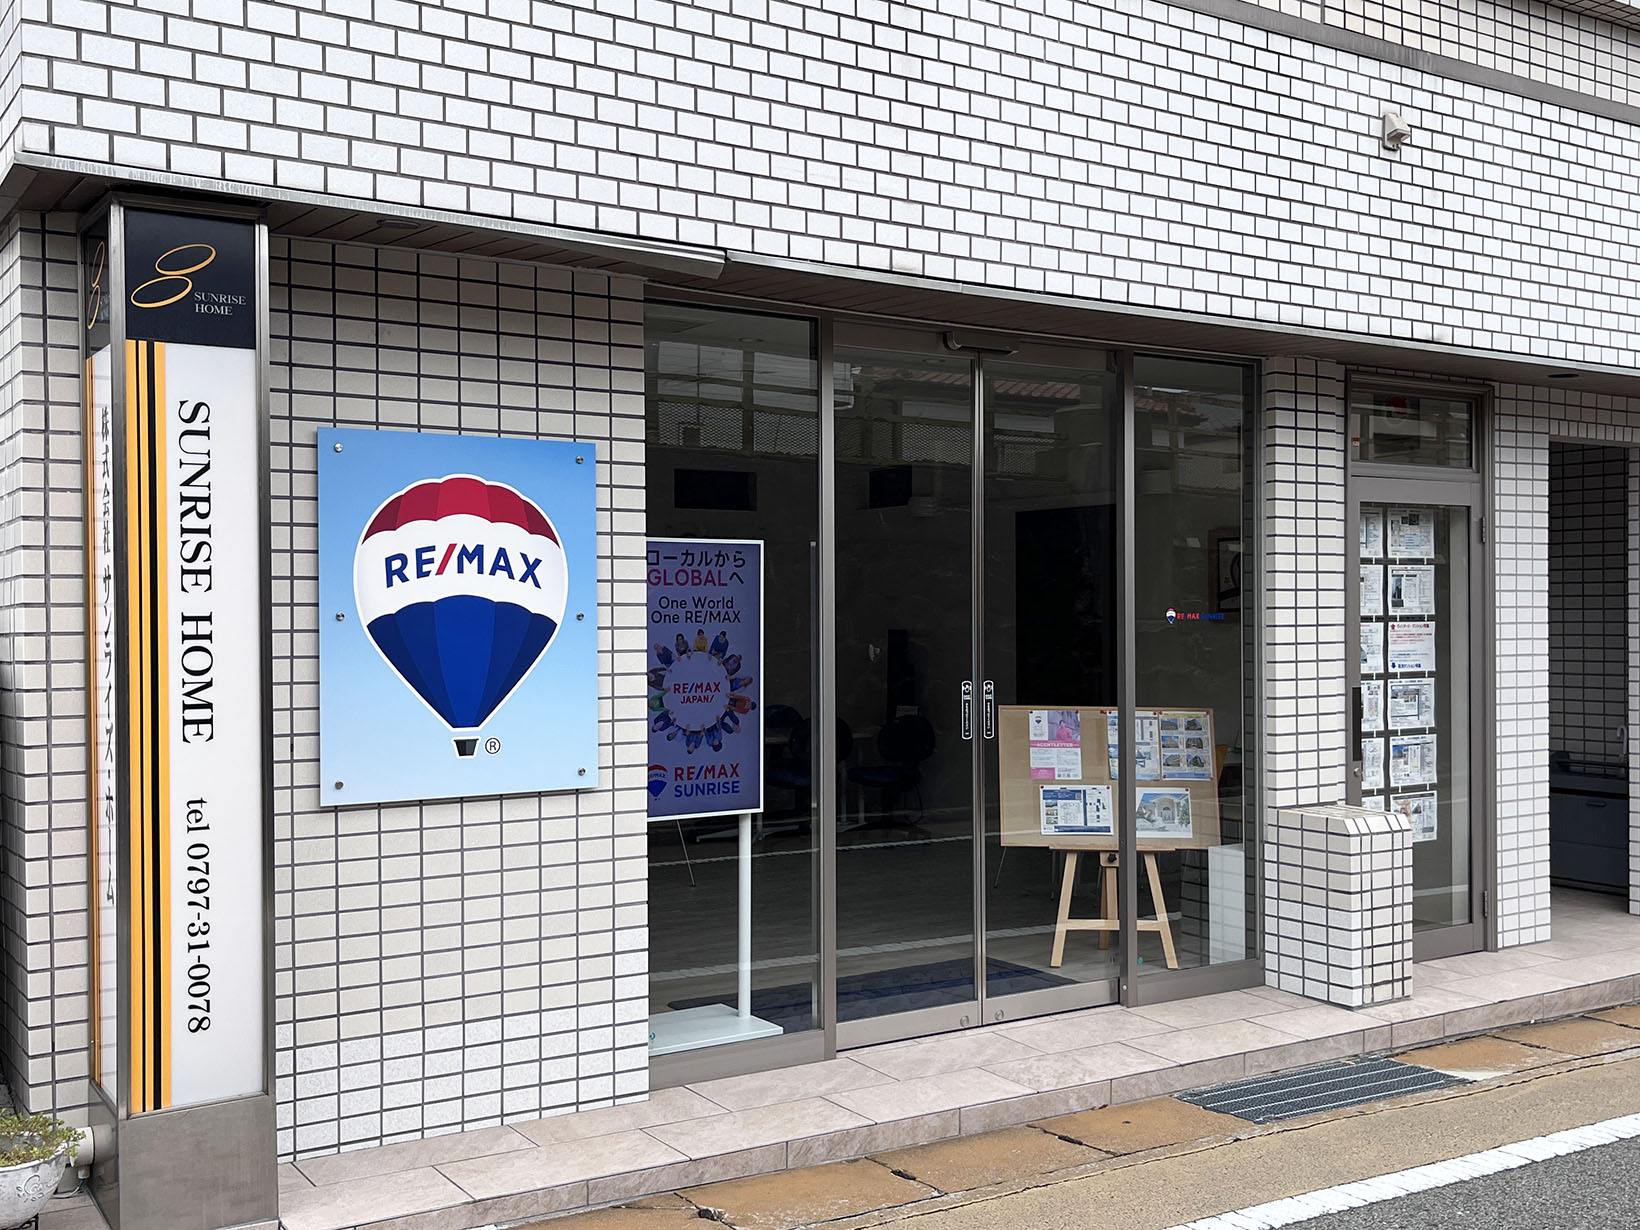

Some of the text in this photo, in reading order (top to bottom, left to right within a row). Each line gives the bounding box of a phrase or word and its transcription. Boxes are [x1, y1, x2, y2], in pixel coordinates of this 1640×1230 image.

[194, 292, 246, 305] SUNRISE
[195, 304, 233, 316] HOME
[384, 542, 543, 590] RE/MAX
[647, 548, 746, 568] ローカルから
[178, 399, 214, 743] SUNRISE HOME
[658, 595, 734, 610] One World
[650, 610, 741, 625] One RE/MAX
[673, 682, 721, 694] RE/MAX
[674, 763, 740, 782] RE/MAX
[674, 780, 741, 798] SUNRISE
[185, 797, 213, 1034] tel 0797-31-0078
